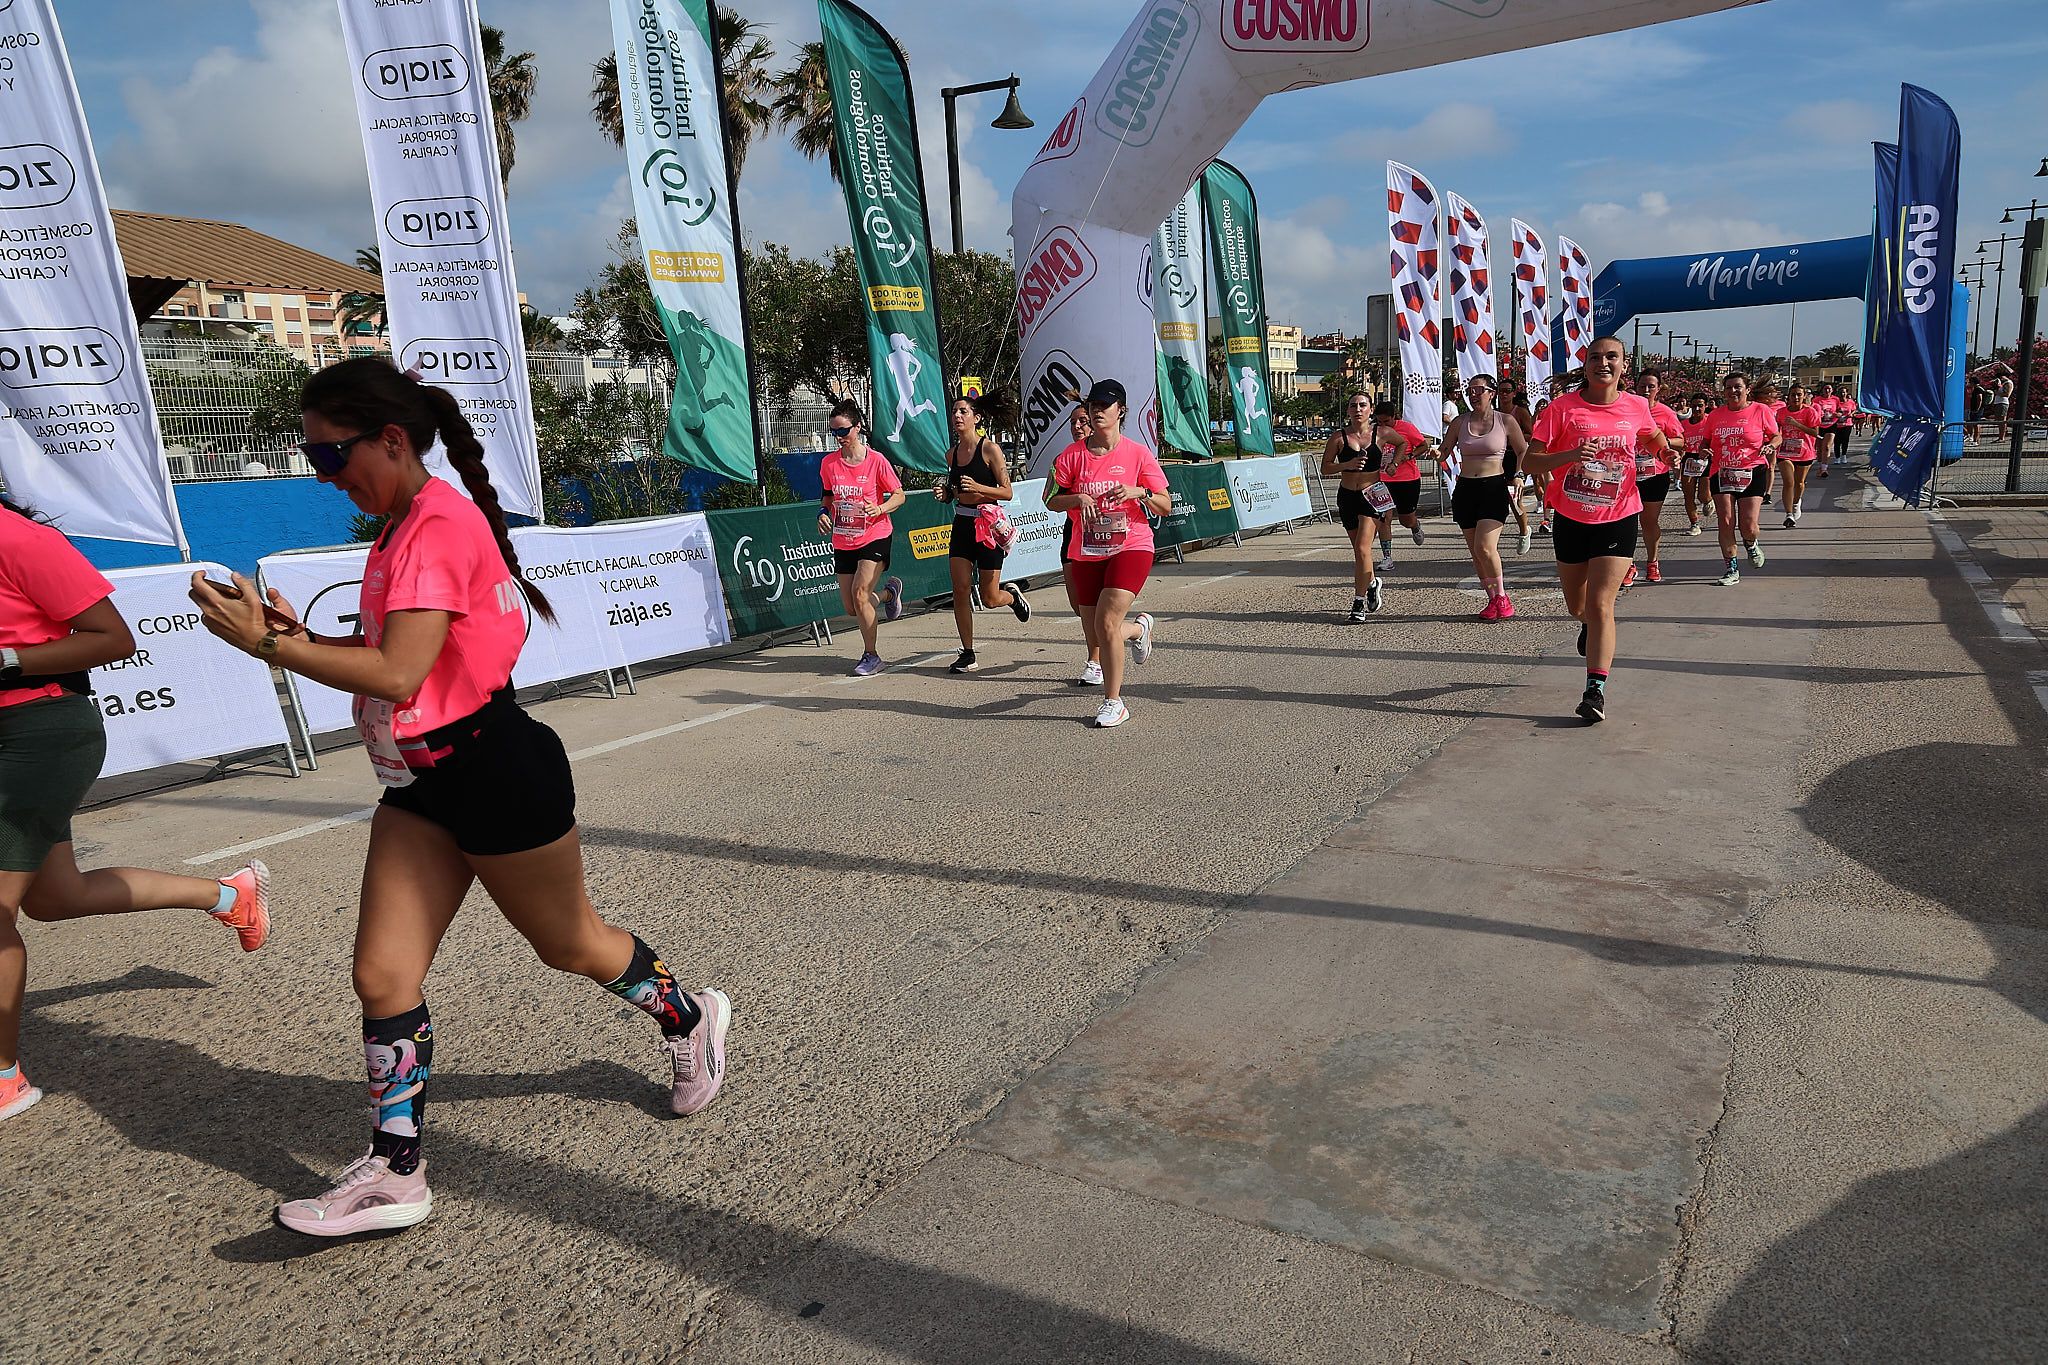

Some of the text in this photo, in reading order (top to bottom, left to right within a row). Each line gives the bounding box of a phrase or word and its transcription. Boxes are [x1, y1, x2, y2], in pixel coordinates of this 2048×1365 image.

[1233, 0, 1357, 42] COSMO
[1105, 7, 1188, 132] COSMO
[1714, 427, 1744, 436] CARRERA
[1578, 435, 1628, 450] CRERA
[832, 484, 863, 497] CARRERA
[1581, 478, 1602, 489] 016
[1008, 511, 1049, 528] Institutos
[912, 533, 928, 545] 900
[929, 531, 940, 543] 131
[1016, 523, 1064, 544] dontológic
[1094, 532, 1112, 540] 016
[780, 540, 835, 562] Instituto
[915, 540, 950, 554] www.ioa.
[525, 547, 708, 582] COSMÉTICA FACIAL, CORPORAL
[787, 557, 836, 582] Odontol
[599, 574, 660, 594] Y CAPILAR
[818, 581, 840, 593] dental
[606, 601, 672, 627] ziaja.es
[137, 612, 202, 636] CORP
